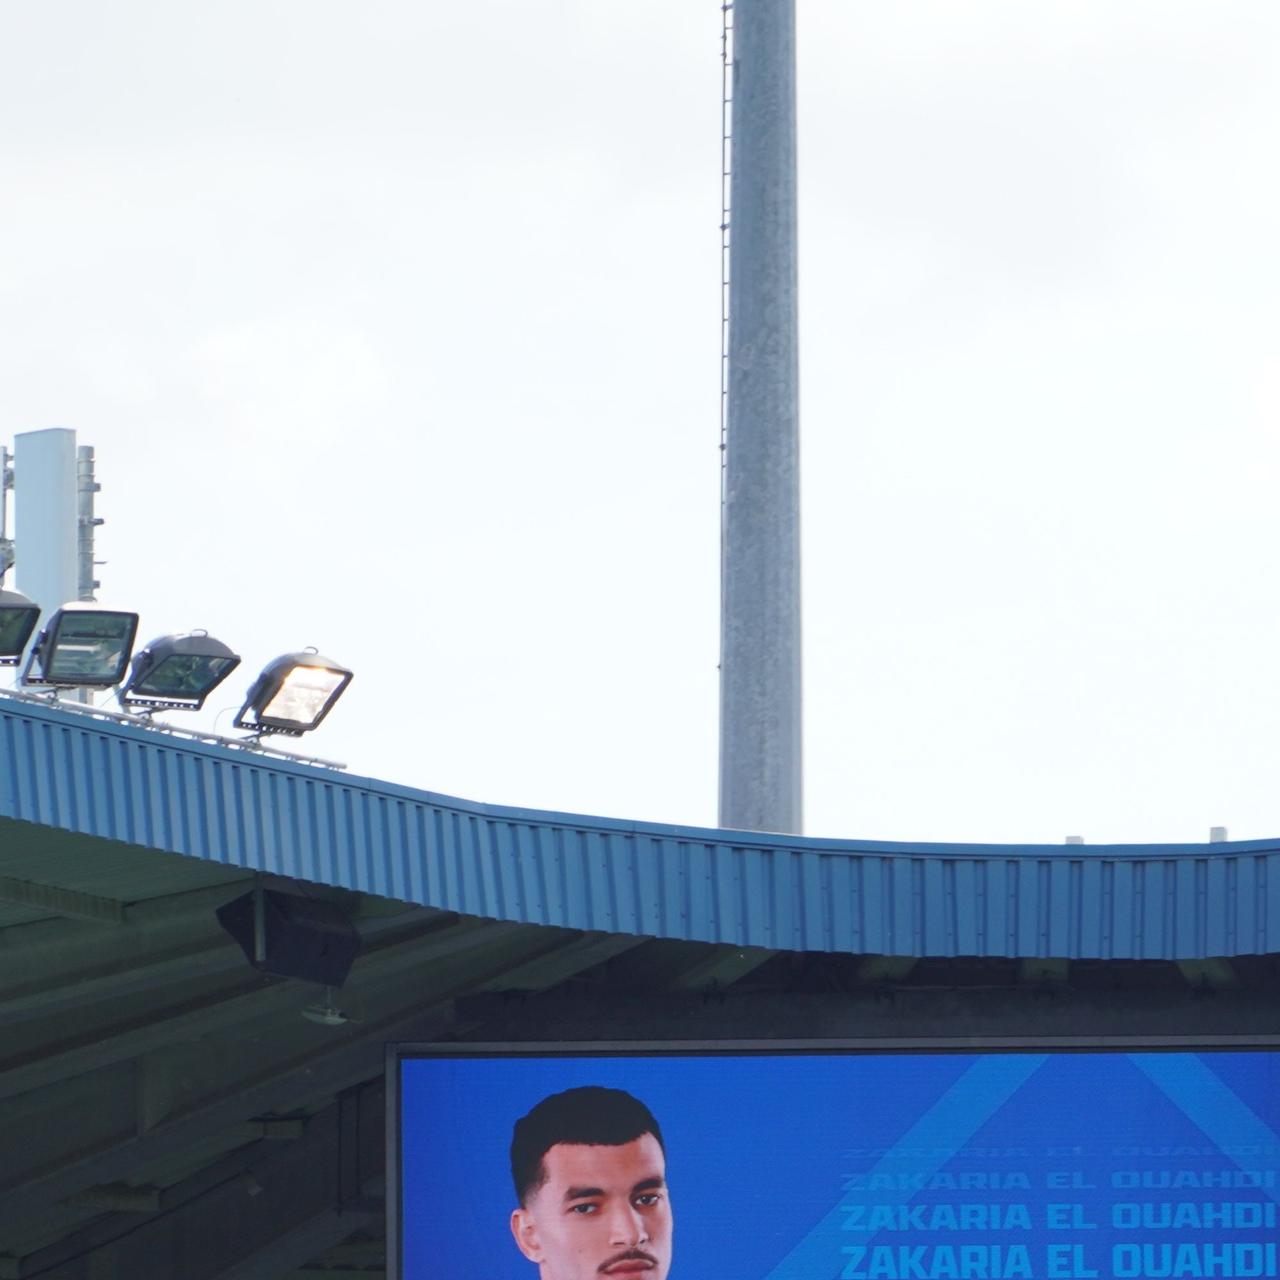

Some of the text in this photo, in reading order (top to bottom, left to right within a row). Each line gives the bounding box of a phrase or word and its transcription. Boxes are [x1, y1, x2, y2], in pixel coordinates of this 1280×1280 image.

[841, 1171, 1275, 1191] ZAKARIA EL OUAHDI
[841, 1202, 1276, 1231] ZAKARIA EL OUAHDI
[841, 1243, 1277, 1280] ZAKARIA EL OUAHDI
